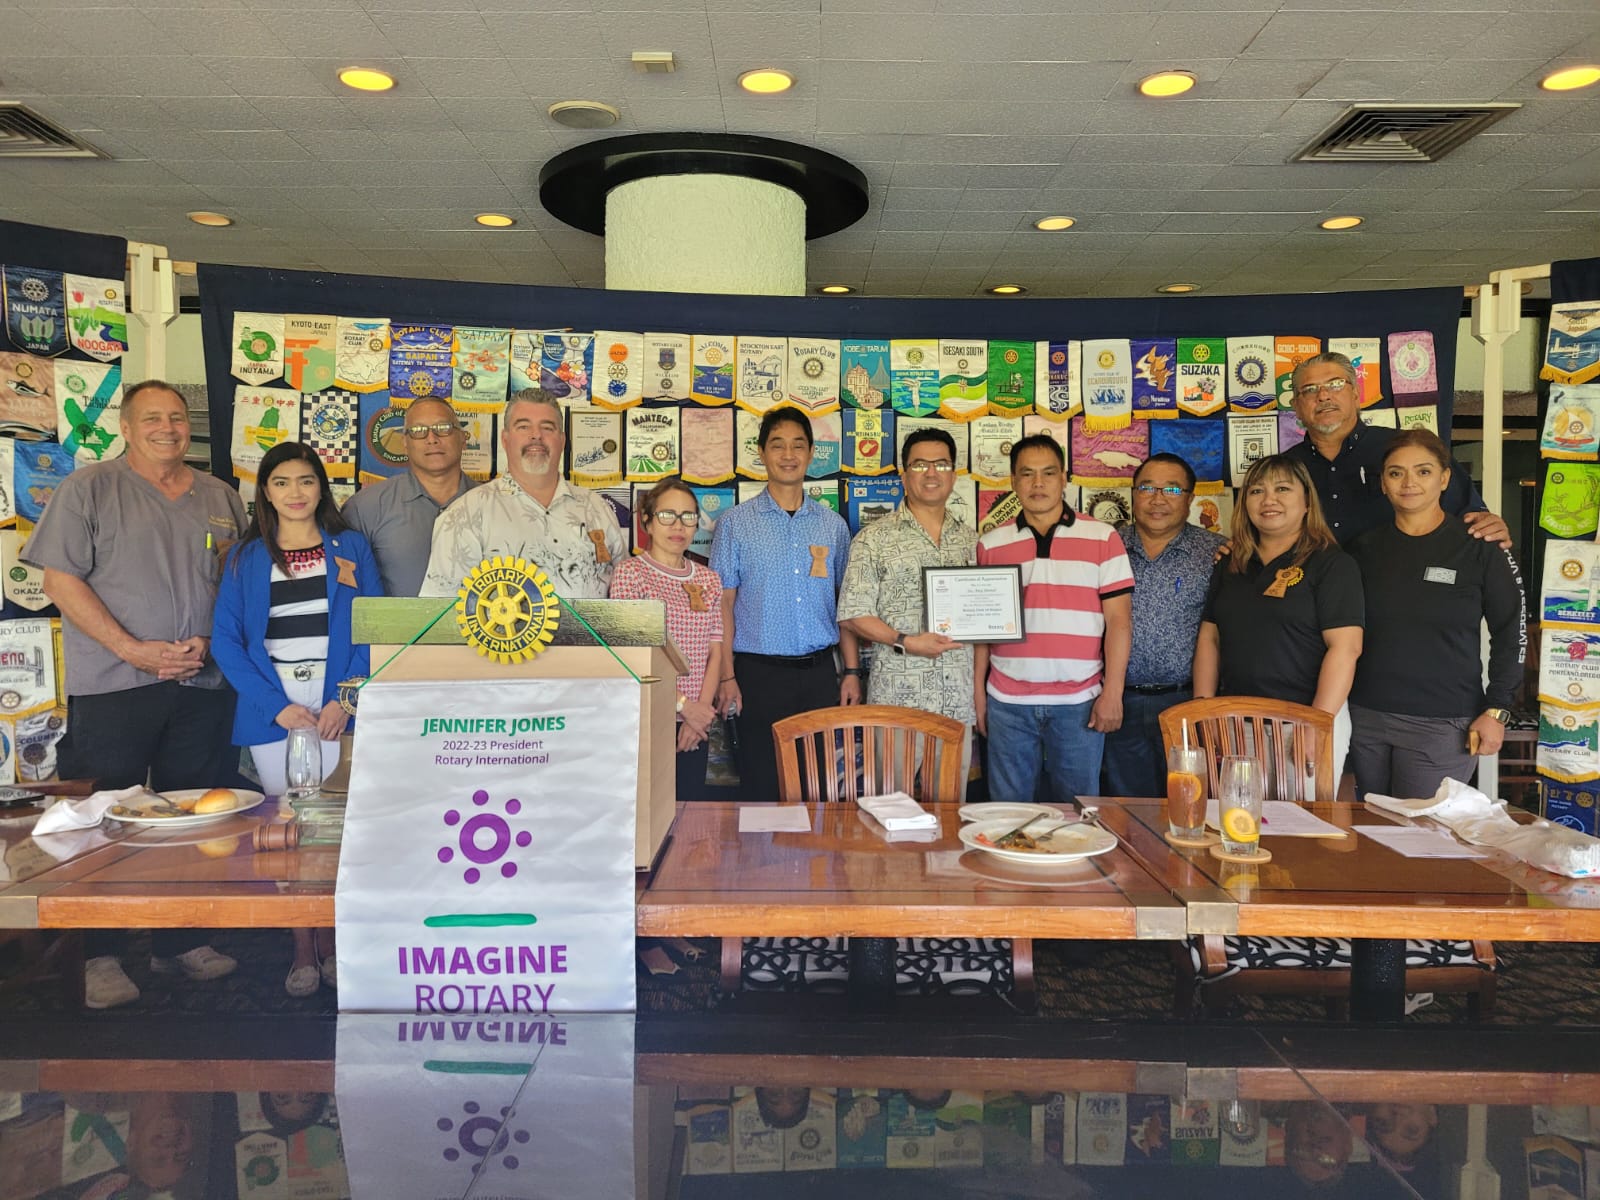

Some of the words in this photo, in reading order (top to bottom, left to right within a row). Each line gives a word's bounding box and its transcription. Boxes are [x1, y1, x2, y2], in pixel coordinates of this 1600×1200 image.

[12, 303, 57, 317] NUMATA
[291, 320, 312, 328] KYOTO
[314, 322, 332, 330] EAST
[393, 326, 425, 339] OTARY
[26, 343, 50, 351] JAPAN
[77, 338, 123, 352] NOOGATA
[943, 346, 965, 356] ISESAKI
[966, 346, 983, 356] SOUTH
[405, 352, 438, 361] SAIPAN
[240, 366, 274, 376] INUYAMA
[1181, 365, 1220, 376] SUZAKA
[379, 412, 394, 422] Club
[631, 414, 673, 427] MANTECA
[383, 452, 408, 462] SINGAPO
[992, 501, 1012, 520] TOKYO
[996, 505, 1017, 525] ROTARY
[475, 569, 523, 592] ROTARY
[1557, 609, 1596, 617] BERKELEY
[15, 626, 41, 634] CLUB
[468, 607, 544, 652] INTERNATIONAL
[1518, 589, 1528, 664] ASSOCIATES
[1, 652, 25, 666] ENO
[421, 718, 507, 736] JENNIFER
[509, 716, 566, 736] JONES
[442, 740, 487, 750] 2022-23
[490, 739, 543, 750] President
[435, 755, 473, 767] Rotary
[475, 753, 549, 765] International
[398, 945, 567, 975] IMAGINE
[415, 984, 556, 1014] ROTARY
